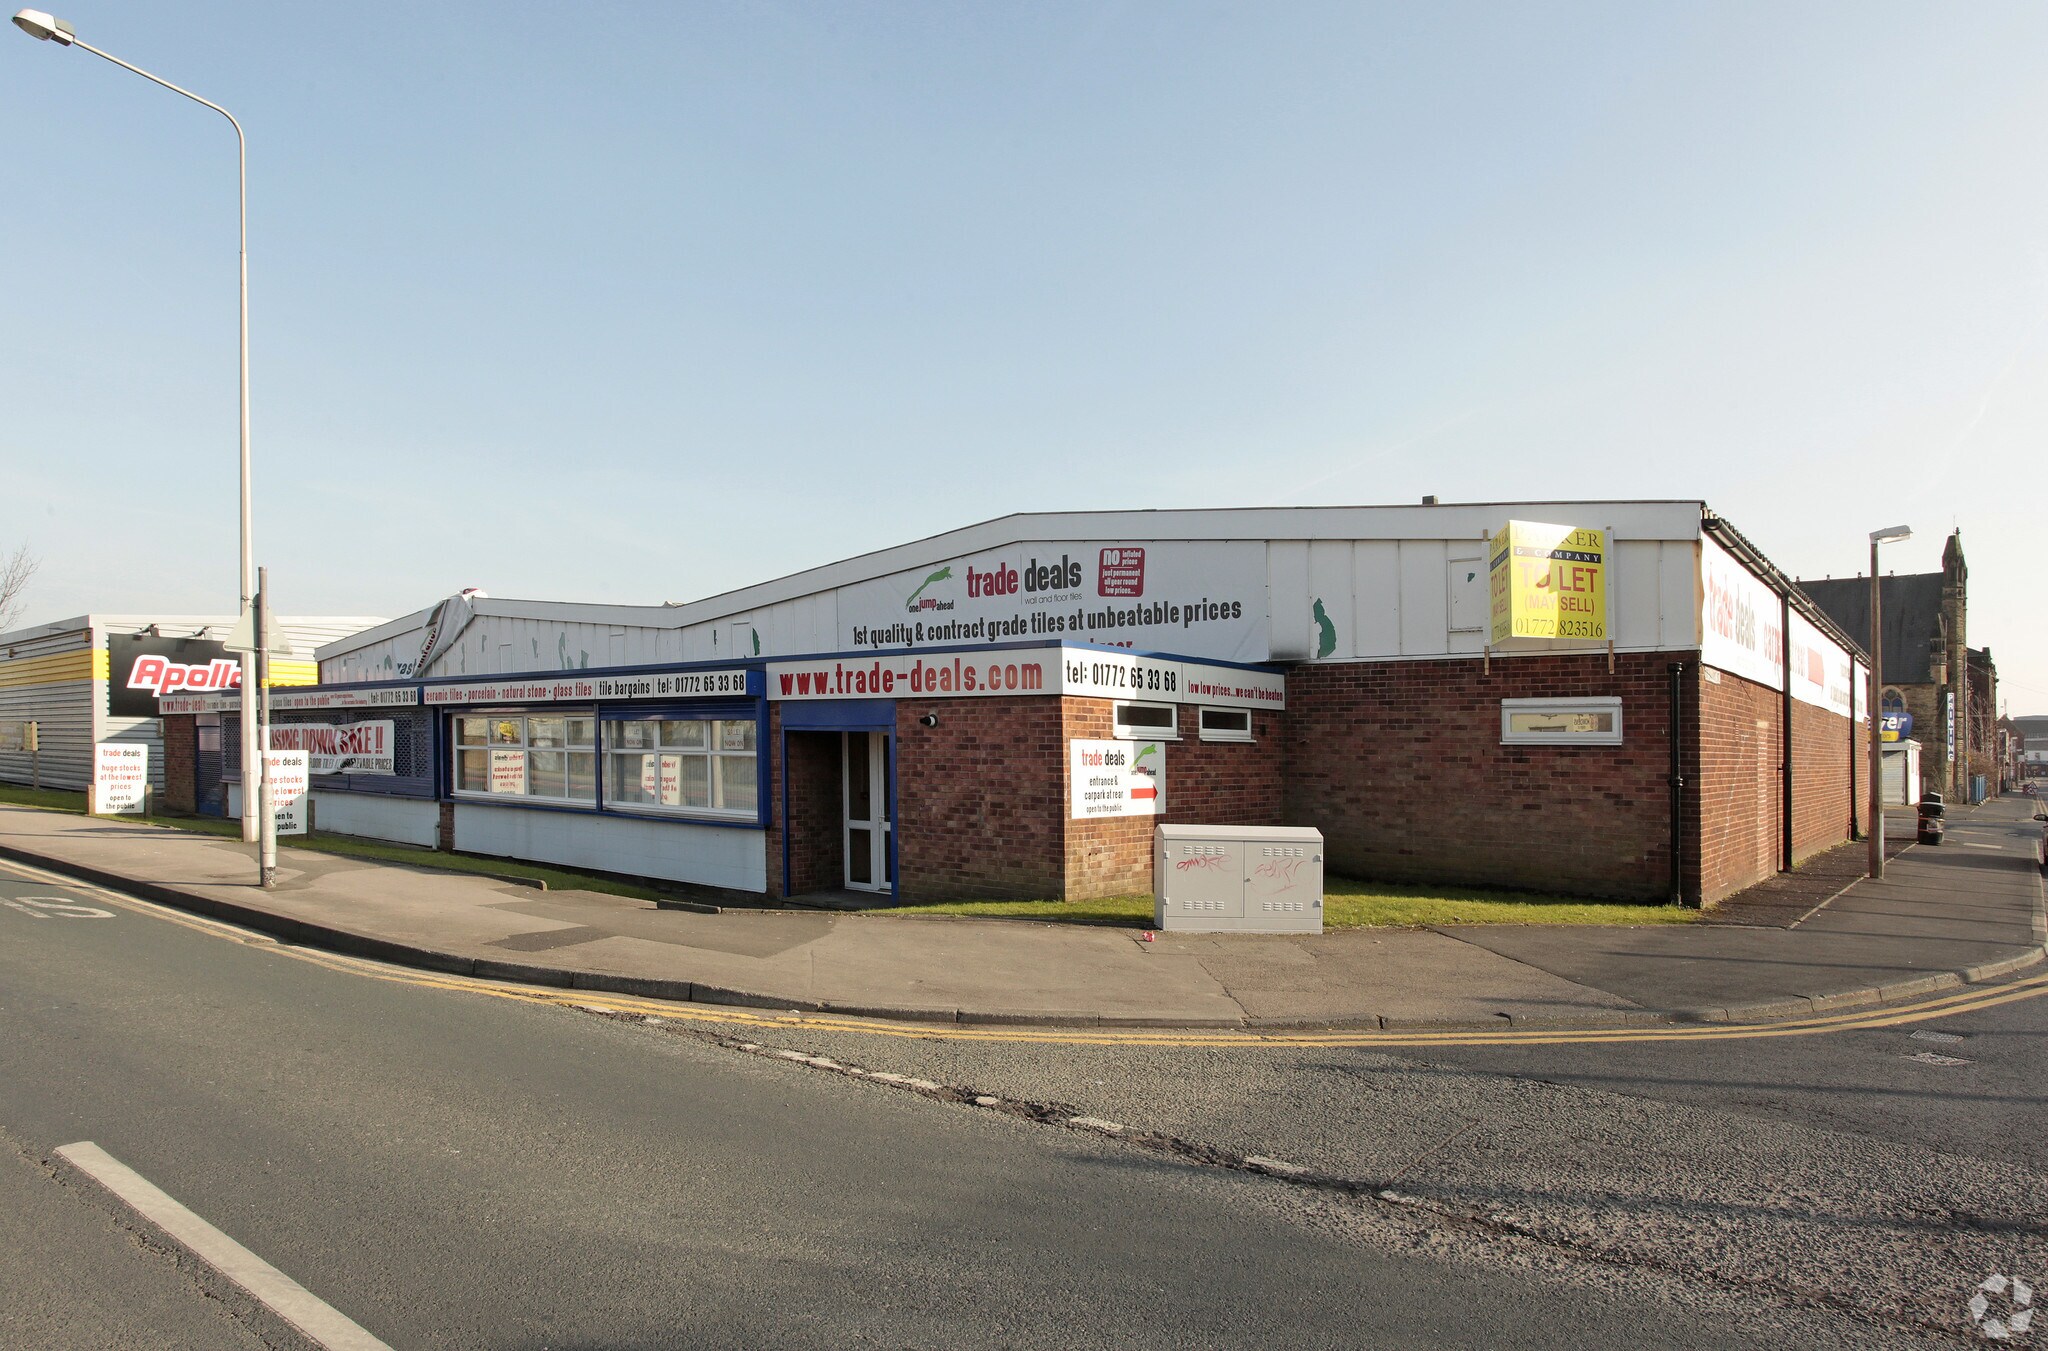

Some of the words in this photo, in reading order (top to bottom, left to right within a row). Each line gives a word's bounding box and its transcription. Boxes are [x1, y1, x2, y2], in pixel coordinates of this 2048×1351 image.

[1103, 550, 1121, 566] no
[1122, 550, 1142, 558] inflated
[1121, 558, 1138, 567] prices
[1534, 549, 1601, 563] COMPANY
[967, 562, 1018, 598] trade
[1024, 554, 1082, 593] deals
[1112, 569, 1141, 578] permanent
[1519, 562, 1551, 588] TO
[1559, 566, 1598, 593] LET
[1122, 577, 1138, 586] round
[908, 603, 919, 613] one
[919, 597, 937, 612] jump
[936, 599, 955, 612] ahead
[1024, 597, 1038, 605] wall
[1038, 595, 1053, 604] and
[1054, 593, 1069, 603] floor
[1069, 592, 1083, 601] tiles
[1560, 596, 1595, 616] SELL)
[853, 626, 868, 646] 1st
[870, 622, 913, 649] quality
[915, 622, 924, 642] &
[927, 617, 985, 641] contract
[988, 614, 1027, 642] grade
[1031, 611, 1065, 634] tiles
[1069, 609, 1084, 631] at
[1087, 601, 1180, 630] unbeatable
[1183, 597, 1242, 629] prices
[1515, 617, 1555, 635] 01772
[1560, 620, 1603, 638] 823516
[129, 655, 242, 697] Apollo
[779, 657, 1043, 696] www.trade-deals.com
[1067, 660, 1088, 684] tel:
[1092, 662, 1126, 688] 01772
[1130, 667, 1143, 689] 65
[1147, 668, 1160, 691] 33
[1164, 670, 1177, 692] 68
[599, 680, 612, 696] tile
[615, 679, 651, 698] bargains
[658, 677, 672, 694] tel:
[675, 676, 700, 693] 01772
[703, 675, 715, 692] 65
[718, 674, 730, 691] 33
[733, 674, 745, 691] 68
[1188, 679, 1199, 694] low
[1200, 681, 1212, 695] low
[1265, 687, 1283, 702] beaten
[380, 691, 394, 703] 01772
[402, 690, 409, 702] 33
[410, 690, 417, 702] 68
[426, 688, 448, 702] ceramic
[450, 687, 463, 701] tiles
[467, 686, 497, 704] porcelain
[501, 684, 526, 699] natural
[527, 685, 547, 698] stone
[552, 683, 573, 703] glass
[575, 682, 592, 697] tiles
[294, 697, 303, 708] open
[317, 694, 330, 707] public
[302, 727, 338, 755] DOWN
[340, 726, 372, 755] SALE
[103, 749, 121, 757] trade
[122, 749, 141, 757] deals
[1082, 748, 1102, 767] trade
[1104, 749, 1125, 767] deals
[282, 757, 303, 766] deals
[375, 758, 392, 770] PRICES
[101, 765, 118, 773] huge
[110, 782, 132, 791] prices
[279, 776, 303, 784] stocks
[1089, 775, 1114, 787] entrance
[281, 787, 305, 795] lowest
[1084, 789, 1106, 803] carpark
[1106, 789, 1112, 799] at
[1112, 789, 1123, 799] rear
[117, 803, 135, 811] public
[273, 799, 293, 807] rices
[1086, 804, 1097, 815] open
[1097, 804, 1102, 812] to
[1109, 803, 1122, 813] public
[277, 822, 297, 832] public
